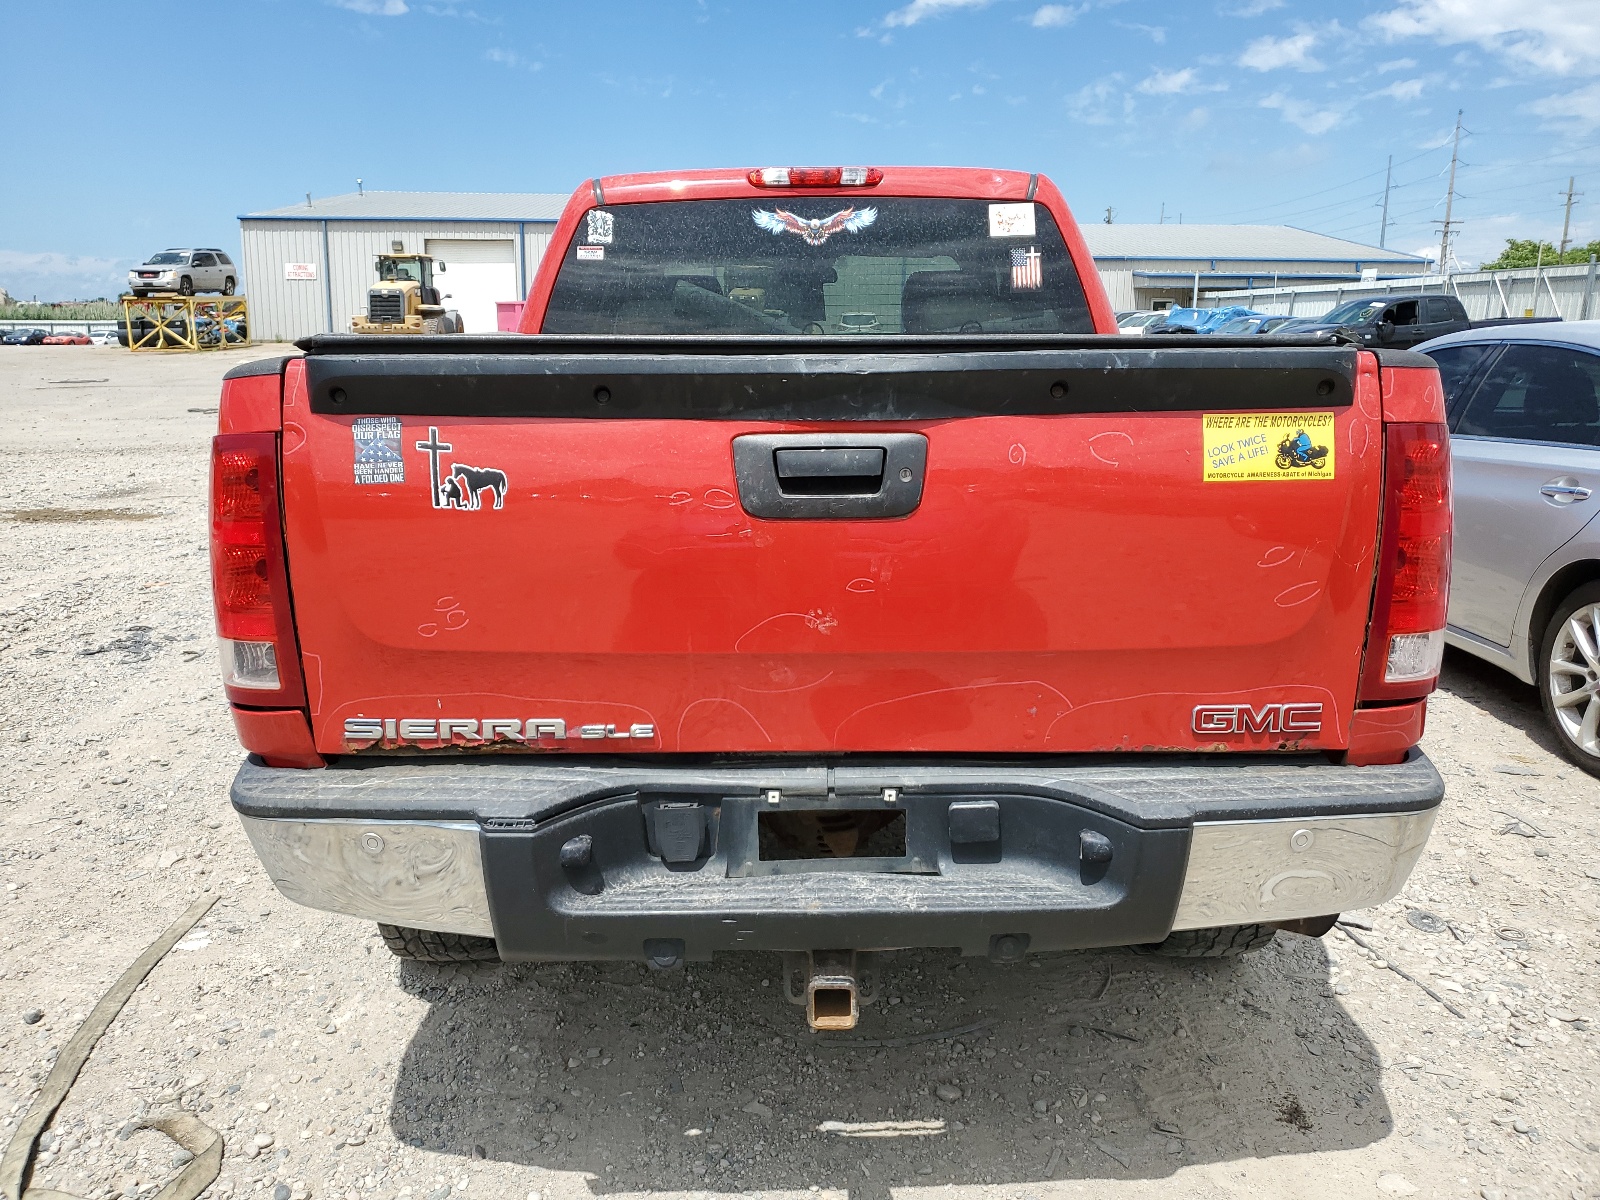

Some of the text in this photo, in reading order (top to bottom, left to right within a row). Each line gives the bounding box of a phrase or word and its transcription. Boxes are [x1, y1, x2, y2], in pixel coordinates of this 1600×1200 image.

[352, 423, 402, 432] DISRESPECT
[1206, 415, 1332, 428] WHERE ARE THE MOTORCYCLES?
[354, 430, 401, 440] OUR FLAG
[1208, 433, 1267, 458] LOOK TWICE
[1212, 445, 1269, 468] SAVE A LIFE!
[355, 473, 405, 484] A FOLDED ONE
[1192, 703, 1323, 733] GMC
[344, 718, 654, 740] SIERRA SLE
